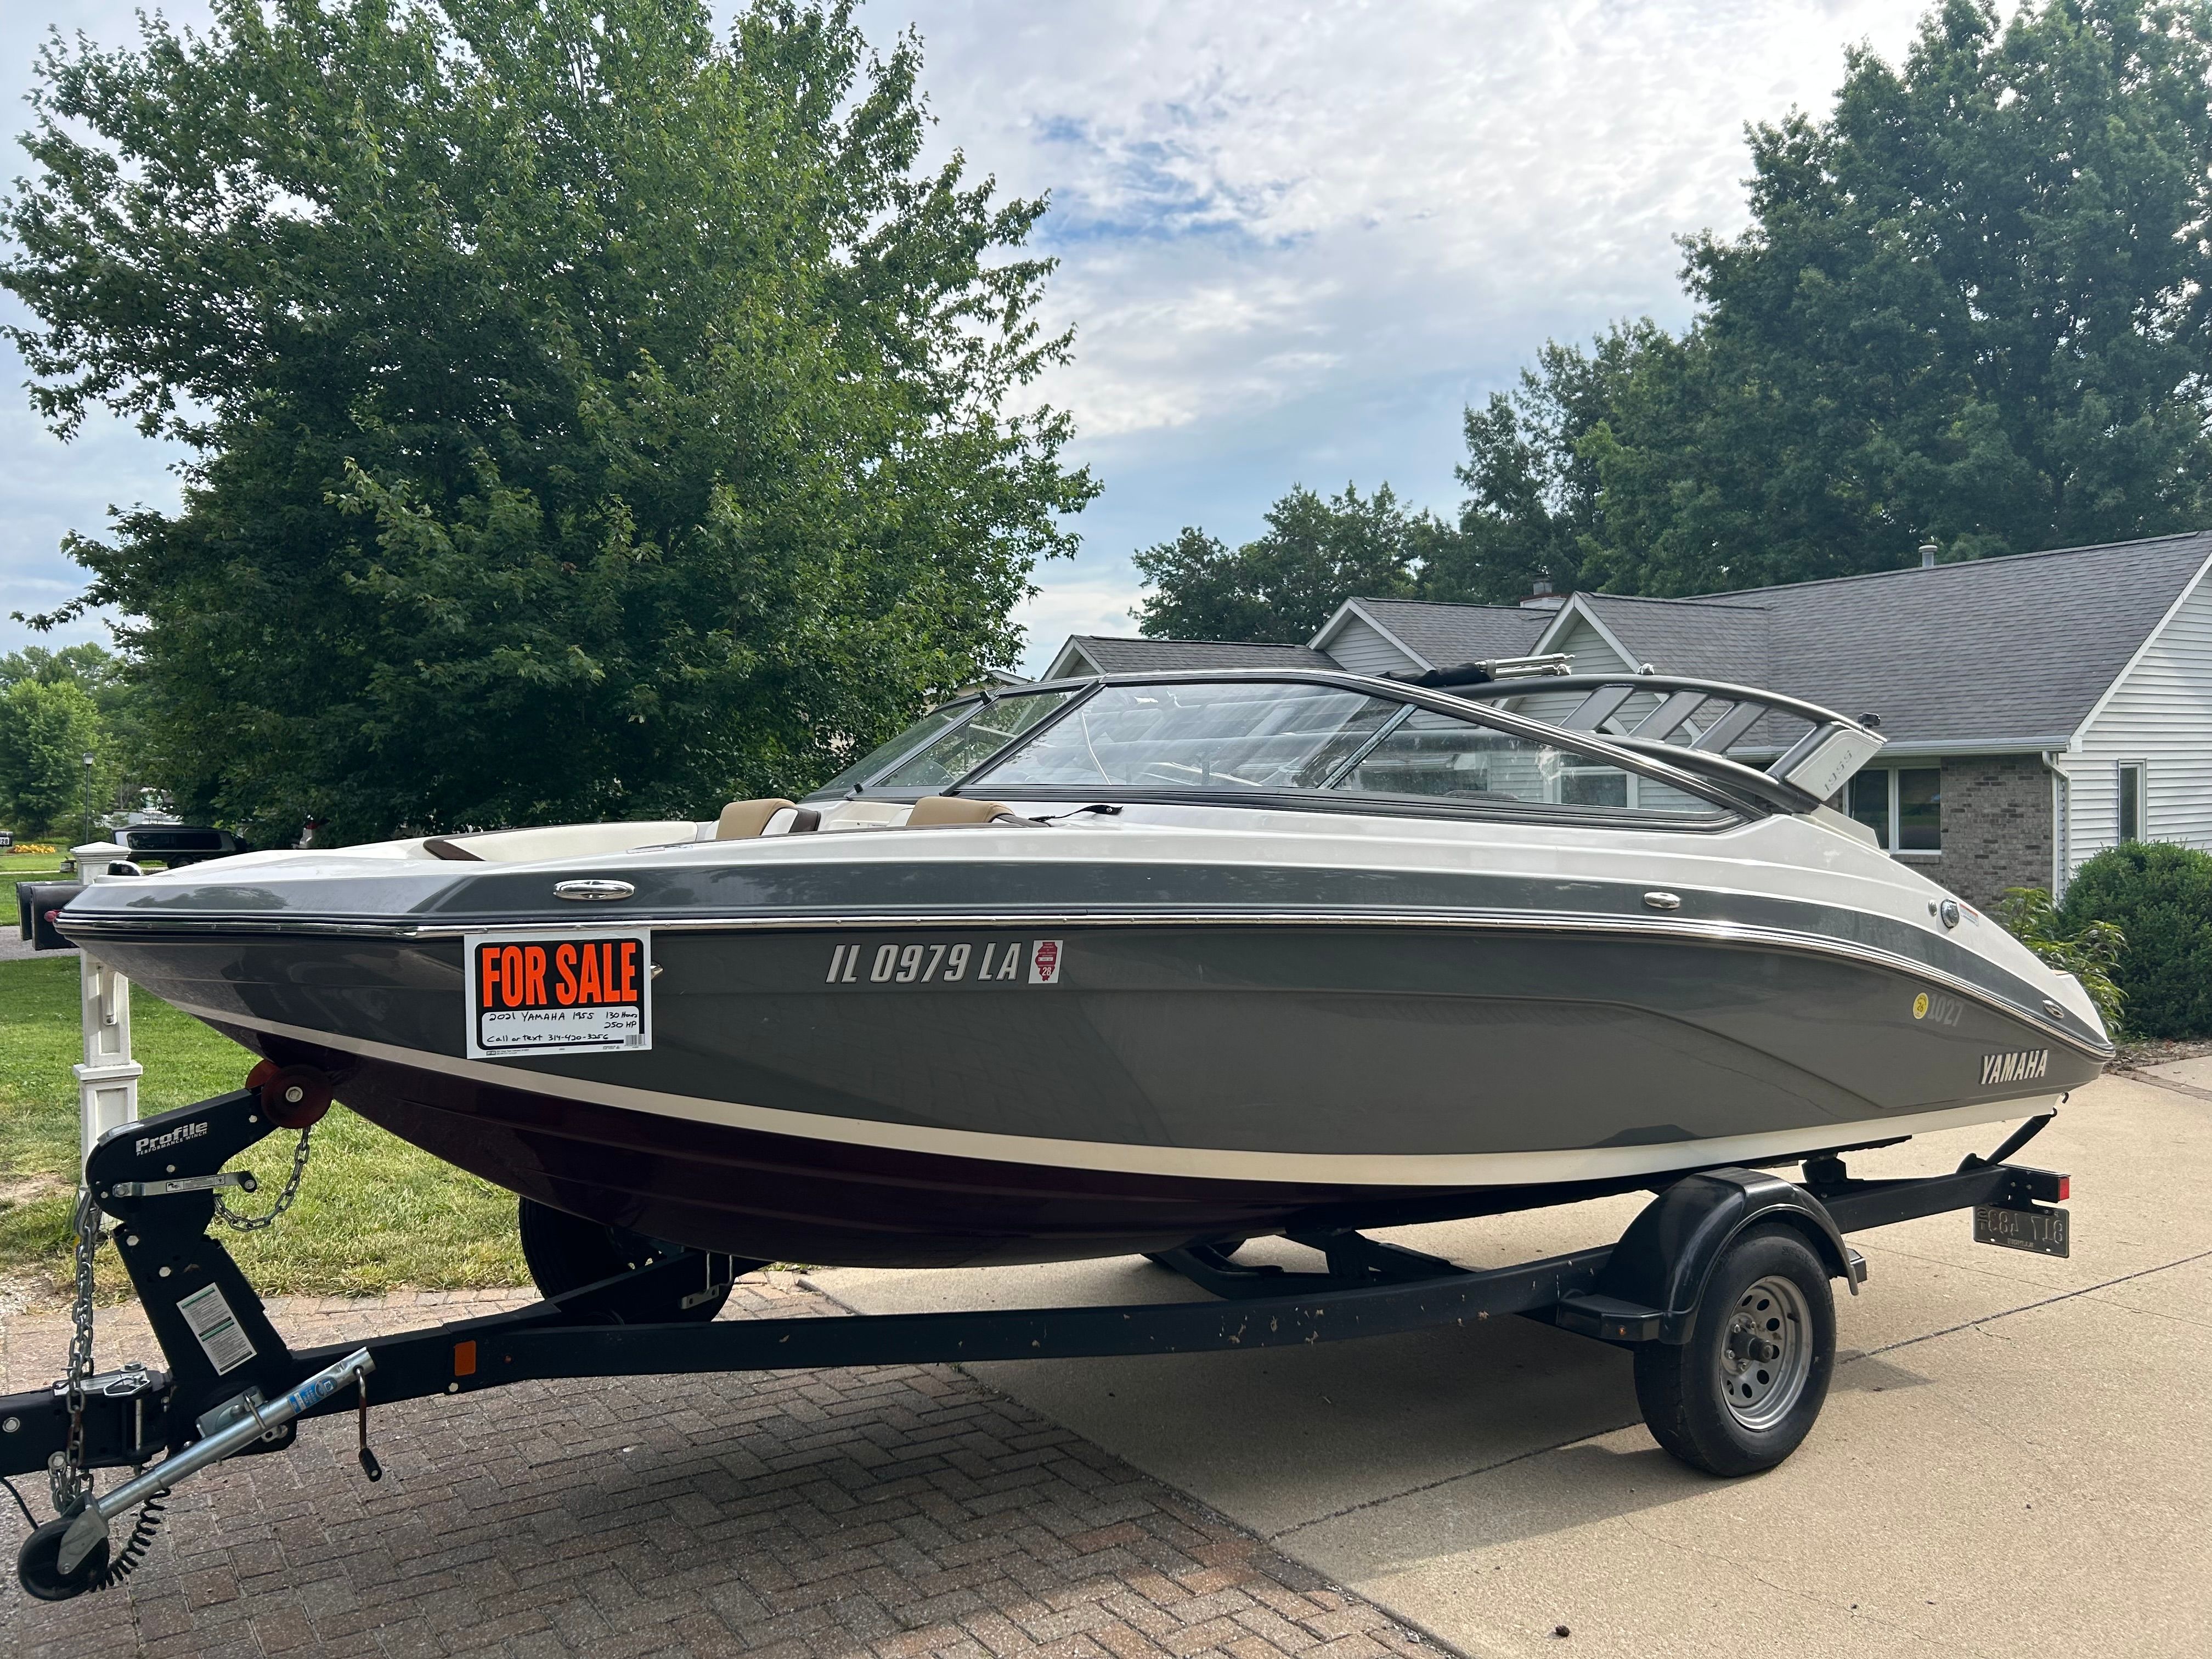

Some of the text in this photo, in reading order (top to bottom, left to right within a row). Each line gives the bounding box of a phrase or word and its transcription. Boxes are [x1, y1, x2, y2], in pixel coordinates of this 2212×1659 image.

[482, 942, 638, 1007] FOR SALE
[825, 944, 861, 984] IL
[869, 943, 972, 984] 0979
[978, 941, 1022, 982] LA
[1042, 967, 1052, 976] 28
[489, 1012, 516, 1021] 2021
[521, 1011, 565, 1022] YAMAHA
[606, 1011, 619, 1019] 130
[1927, 994, 1964, 1028] 1027
[1979, 1048, 2048, 1085] YAMAHA
[136, 1122, 208, 1153] Profile
[136, 1131, 207, 1156] PERFORMANCE WINCH
